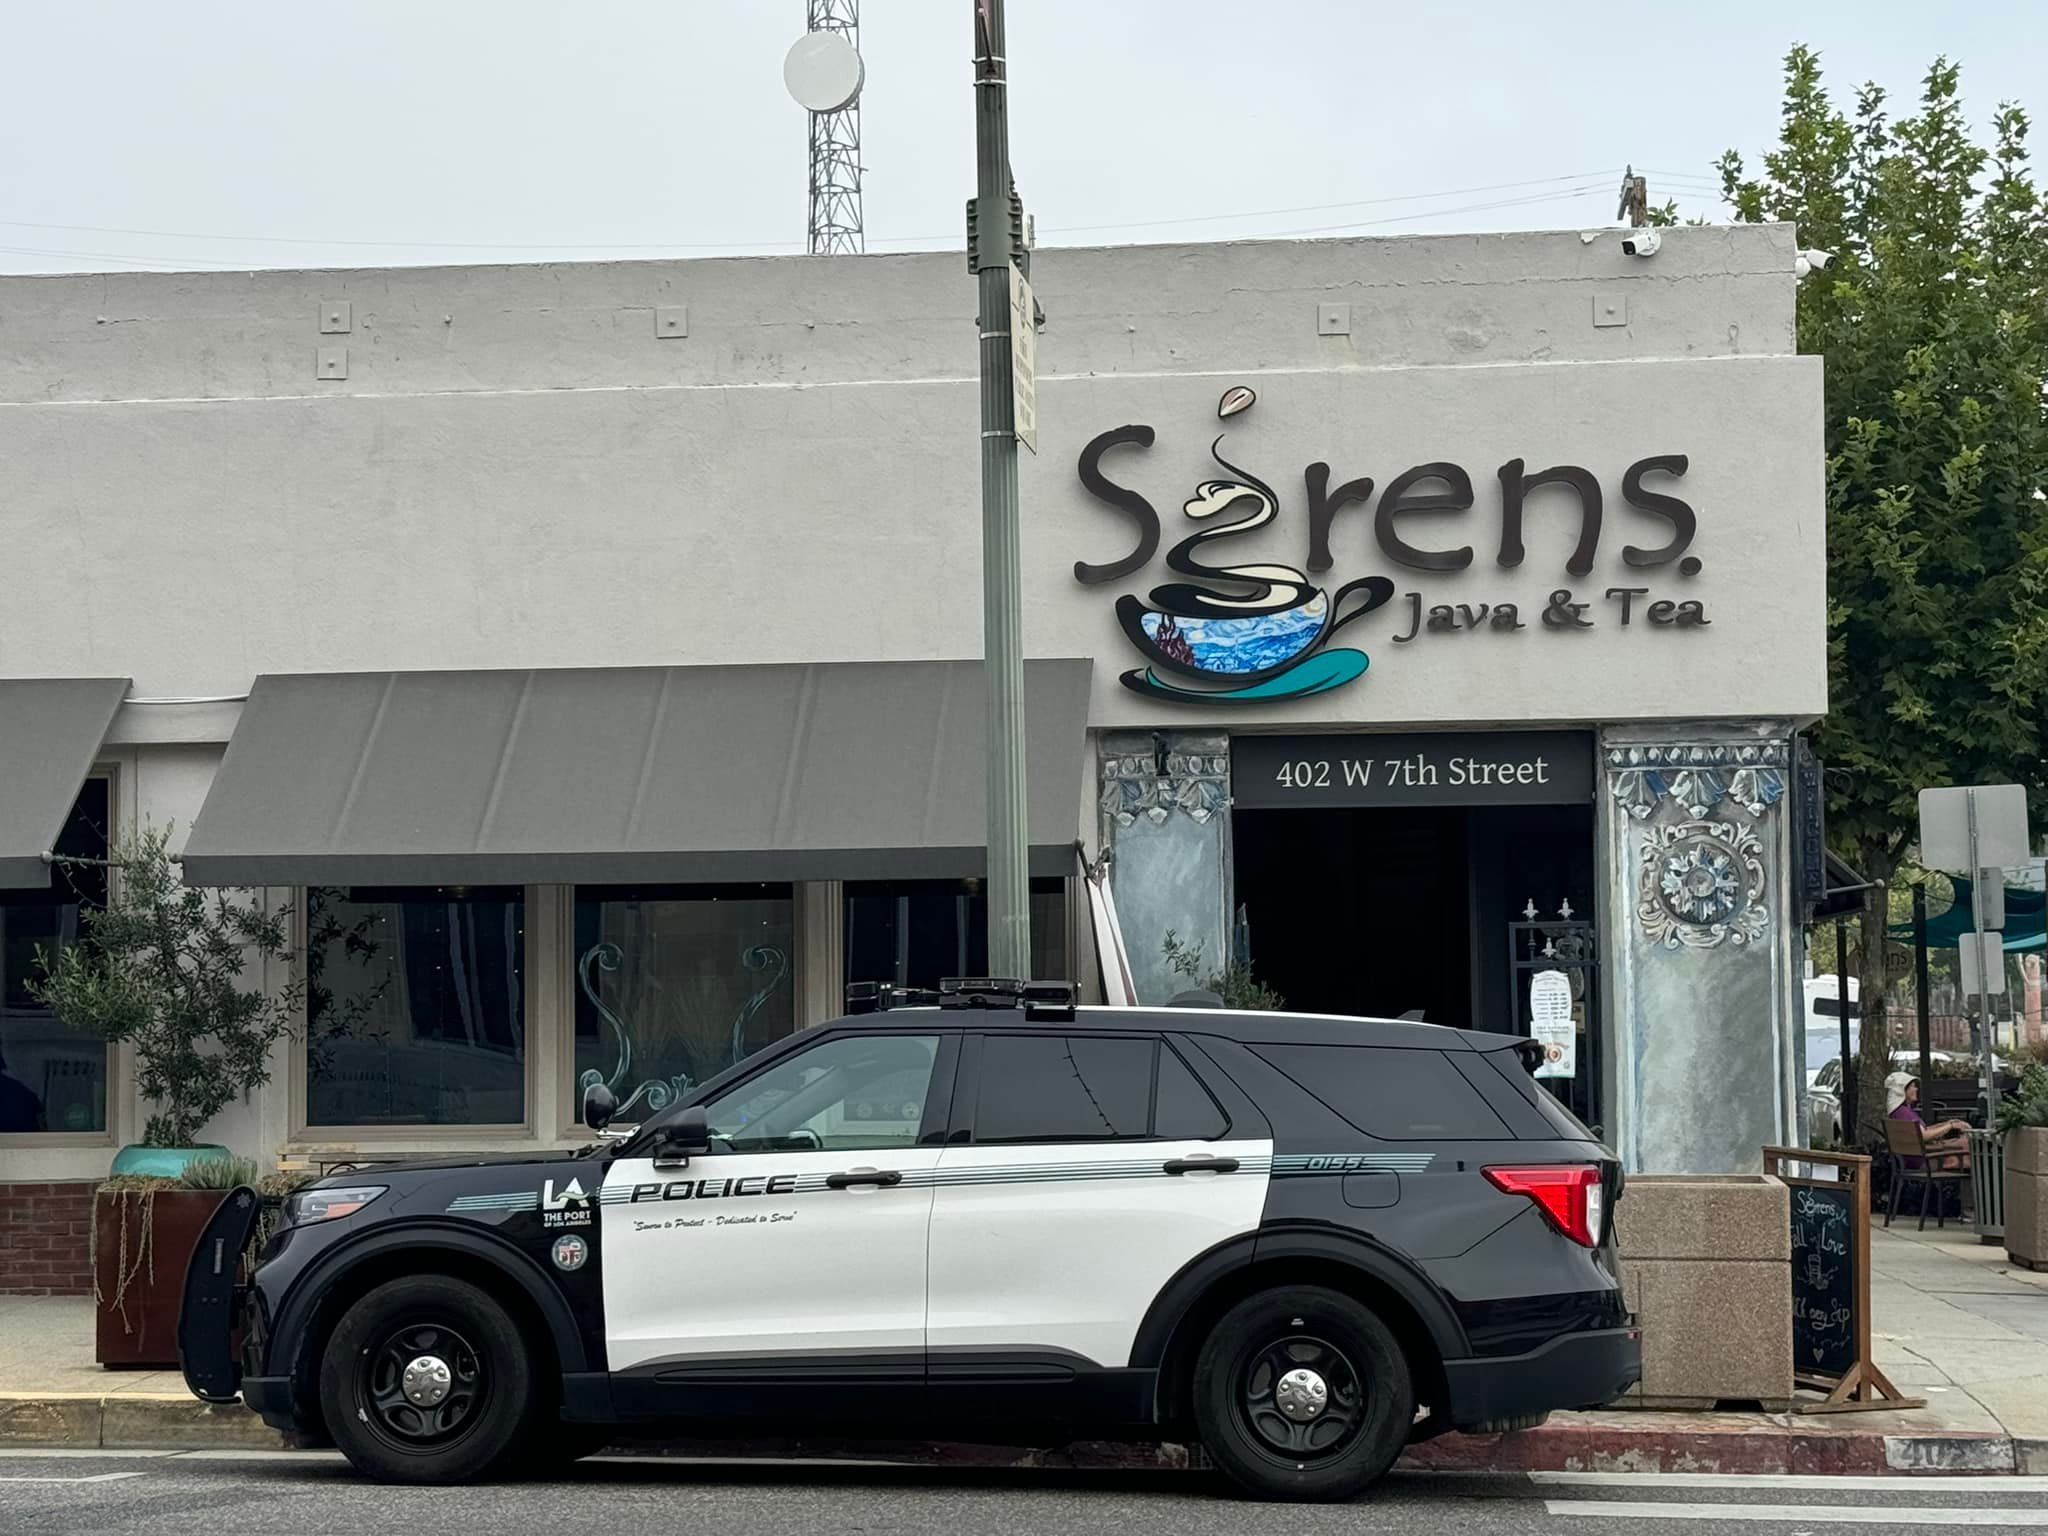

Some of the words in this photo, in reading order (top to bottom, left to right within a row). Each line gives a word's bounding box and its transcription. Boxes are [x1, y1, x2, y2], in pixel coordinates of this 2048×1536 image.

[1391, 591, 1525, 643] Java
[1540, 589, 1595, 628] &
[1605, 587, 1712, 627] Tea
[1275, 760, 1331, 788] 402
[1341, 759, 1377, 787] W
[1384, 756, 1439, 787] 7th
[1448, 755, 1550, 786] Street
[543, 1177, 590, 1210] LA
[630, 1174, 799, 1204] POLICE
[543, 1212, 563, 1222] THE
[564, 1210, 591, 1221] PORT
[664, 1220, 673, 1229] to
[675, 1218, 705, 1229] Protect
[716, 1214, 757, 1226] Dedicated
[760, 1214, 767, 1223] to
[1821, 1222, 1847, 1256] Love
